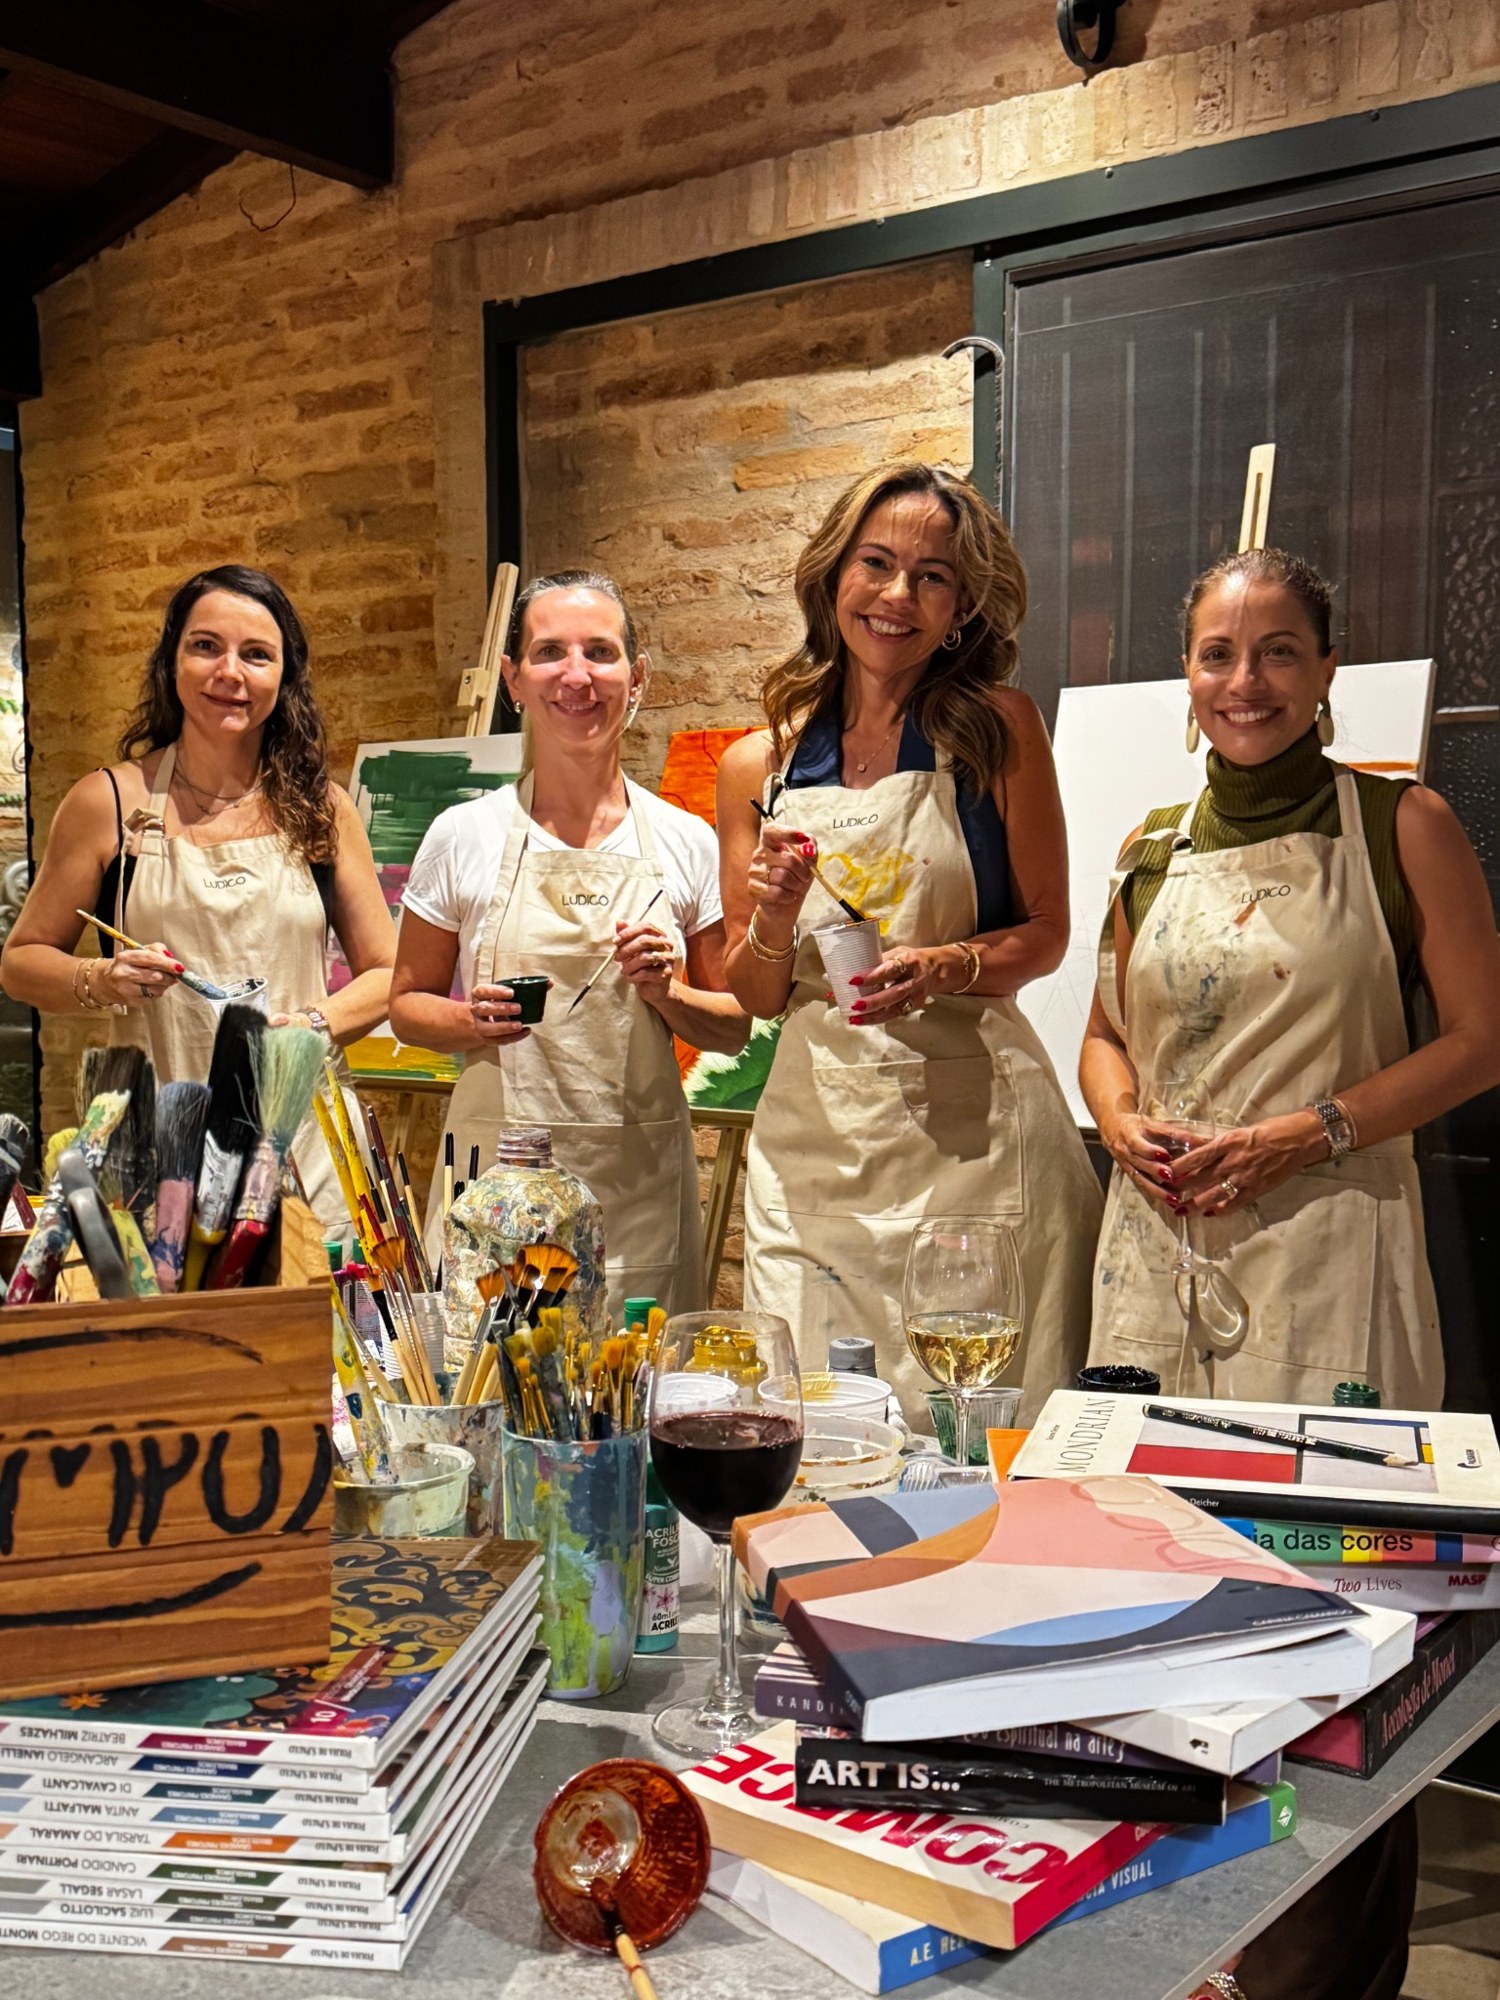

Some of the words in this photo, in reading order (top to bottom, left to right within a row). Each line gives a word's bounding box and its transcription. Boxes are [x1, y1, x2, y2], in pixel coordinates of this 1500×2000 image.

[832, 813, 879, 830] LUDICO
[202, 876, 246, 890] LUDICO
[561, 894, 610, 907] LUDICO
[1240, 884, 1291, 904] LUDICO
[1053, 1397, 1117, 1473] MONDRIAN
[1189, 1498, 1220, 1508] Deicher
[1283, 1528, 1332, 1551] das
[1340, 1533, 1414, 1551] cores
[1334, 1577, 1362, 1593] Two
[1366, 1576, 1402, 1592] Lives
[1447, 1574, 1487, 1588] MASP
[1430, 1642, 1456, 1695] Monet
[309, 1710, 338, 1724] 10
[20, 1726, 78, 1740] MILHAZES
[81, 1729, 126, 1744] BEATRIZ
[1065, 1731, 1081, 1752] na
[0, 1748, 45, 1761] IANELLI
[47, 1753, 119, 1766] ARCANGELO
[806, 1758, 886, 1788] ART
[897, 1762, 961, 1792] IS...
[42, 1778, 117, 1792] CAVALCANTI
[119, 1782, 132, 1793] DI
[1044, 1778, 1060, 1787] THE
[1062, 1779, 1128, 1790] METROPOLITAN
[1129, 1781, 1167, 1791] MUSEUM
[44, 1801, 102, 1815] MALFATTI
[105, 1806, 140, 1817] ANITA
[30, 1827, 81, 1840] AMARAL
[84, 1830, 102, 1841] DO
[106, 1831, 151, 1844] TARSILA
[16, 1854, 79, 1869] PORTINARI
[81, 1859, 137, 1874] CANDIDO
[1111, 1859, 1154, 1890] VISUAL
[60, 1883, 103, 1897] SEGALL
[106, 1886, 143, 1899] LASAR
[60, 1903, 127, 1917] SACILOTTO
[128, 1906, 154, 1919] LUIZ
[41, 1930, 74, 1943] REGO
[77, 1932, 96, 1944] DO
[99, 1933, 148, 1947] VICENTE
